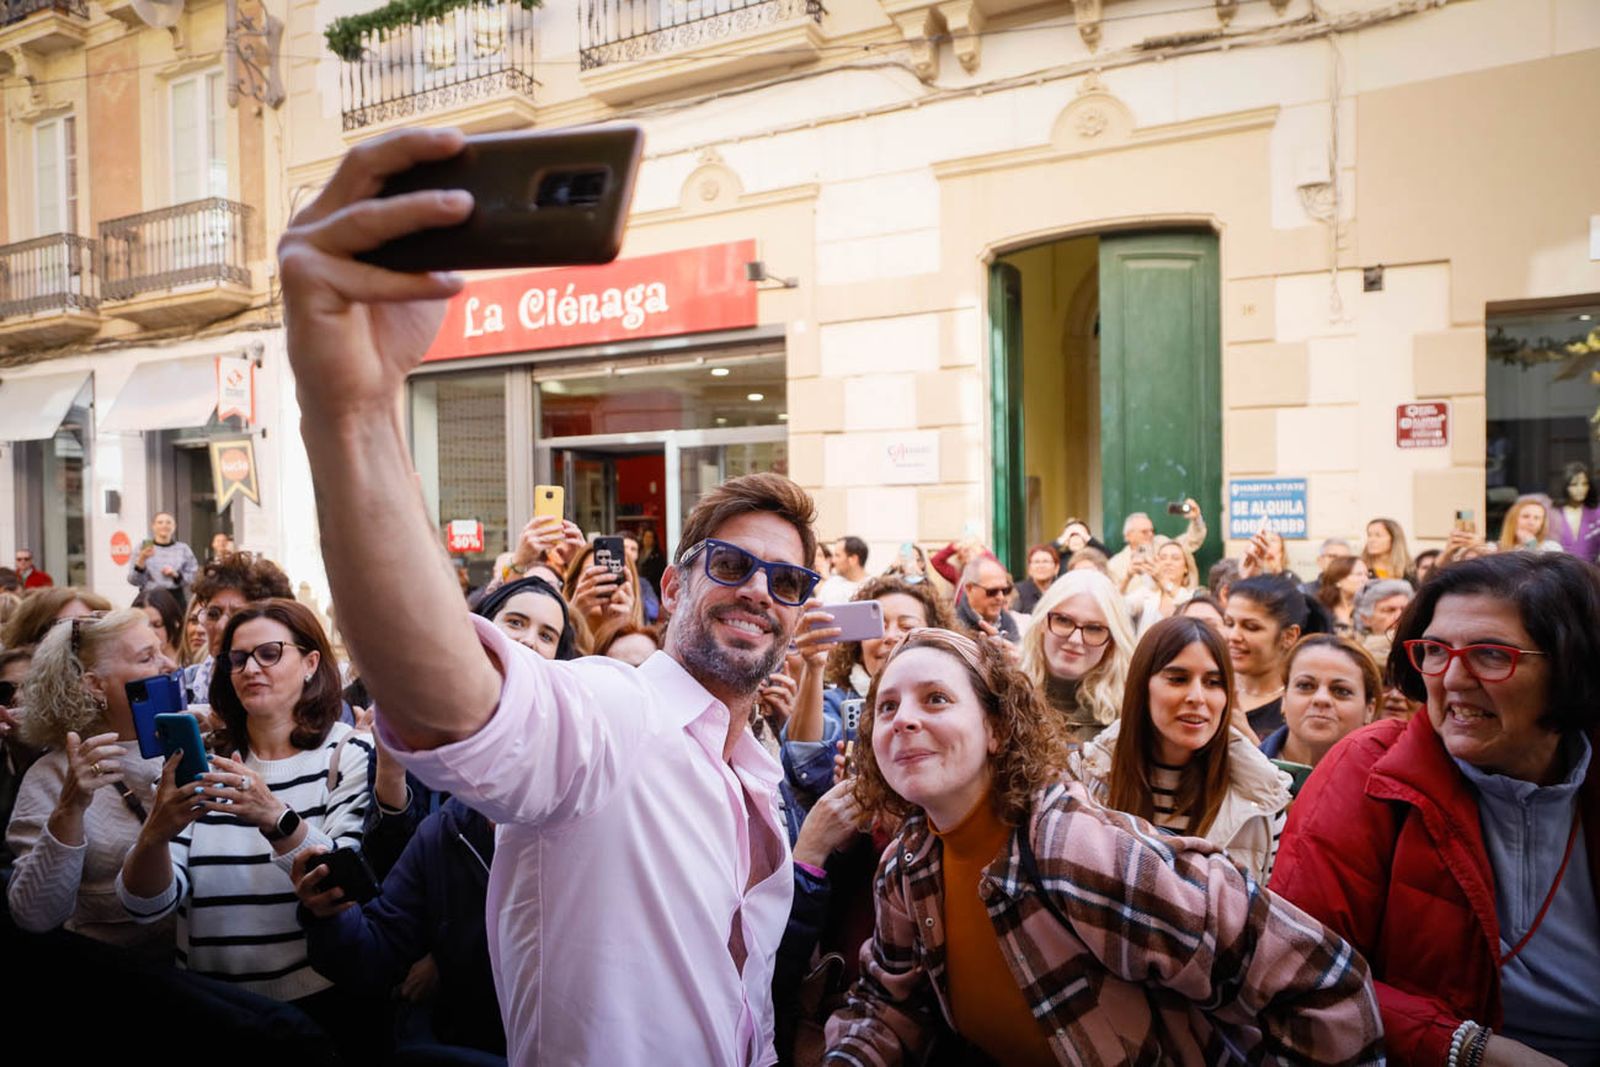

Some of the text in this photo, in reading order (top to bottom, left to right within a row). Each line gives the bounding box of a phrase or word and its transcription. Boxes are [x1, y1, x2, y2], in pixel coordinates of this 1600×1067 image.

[464, 282, 669, 338] La Ciénaga
[1251, 499, 1304, 514] ALQUILA
